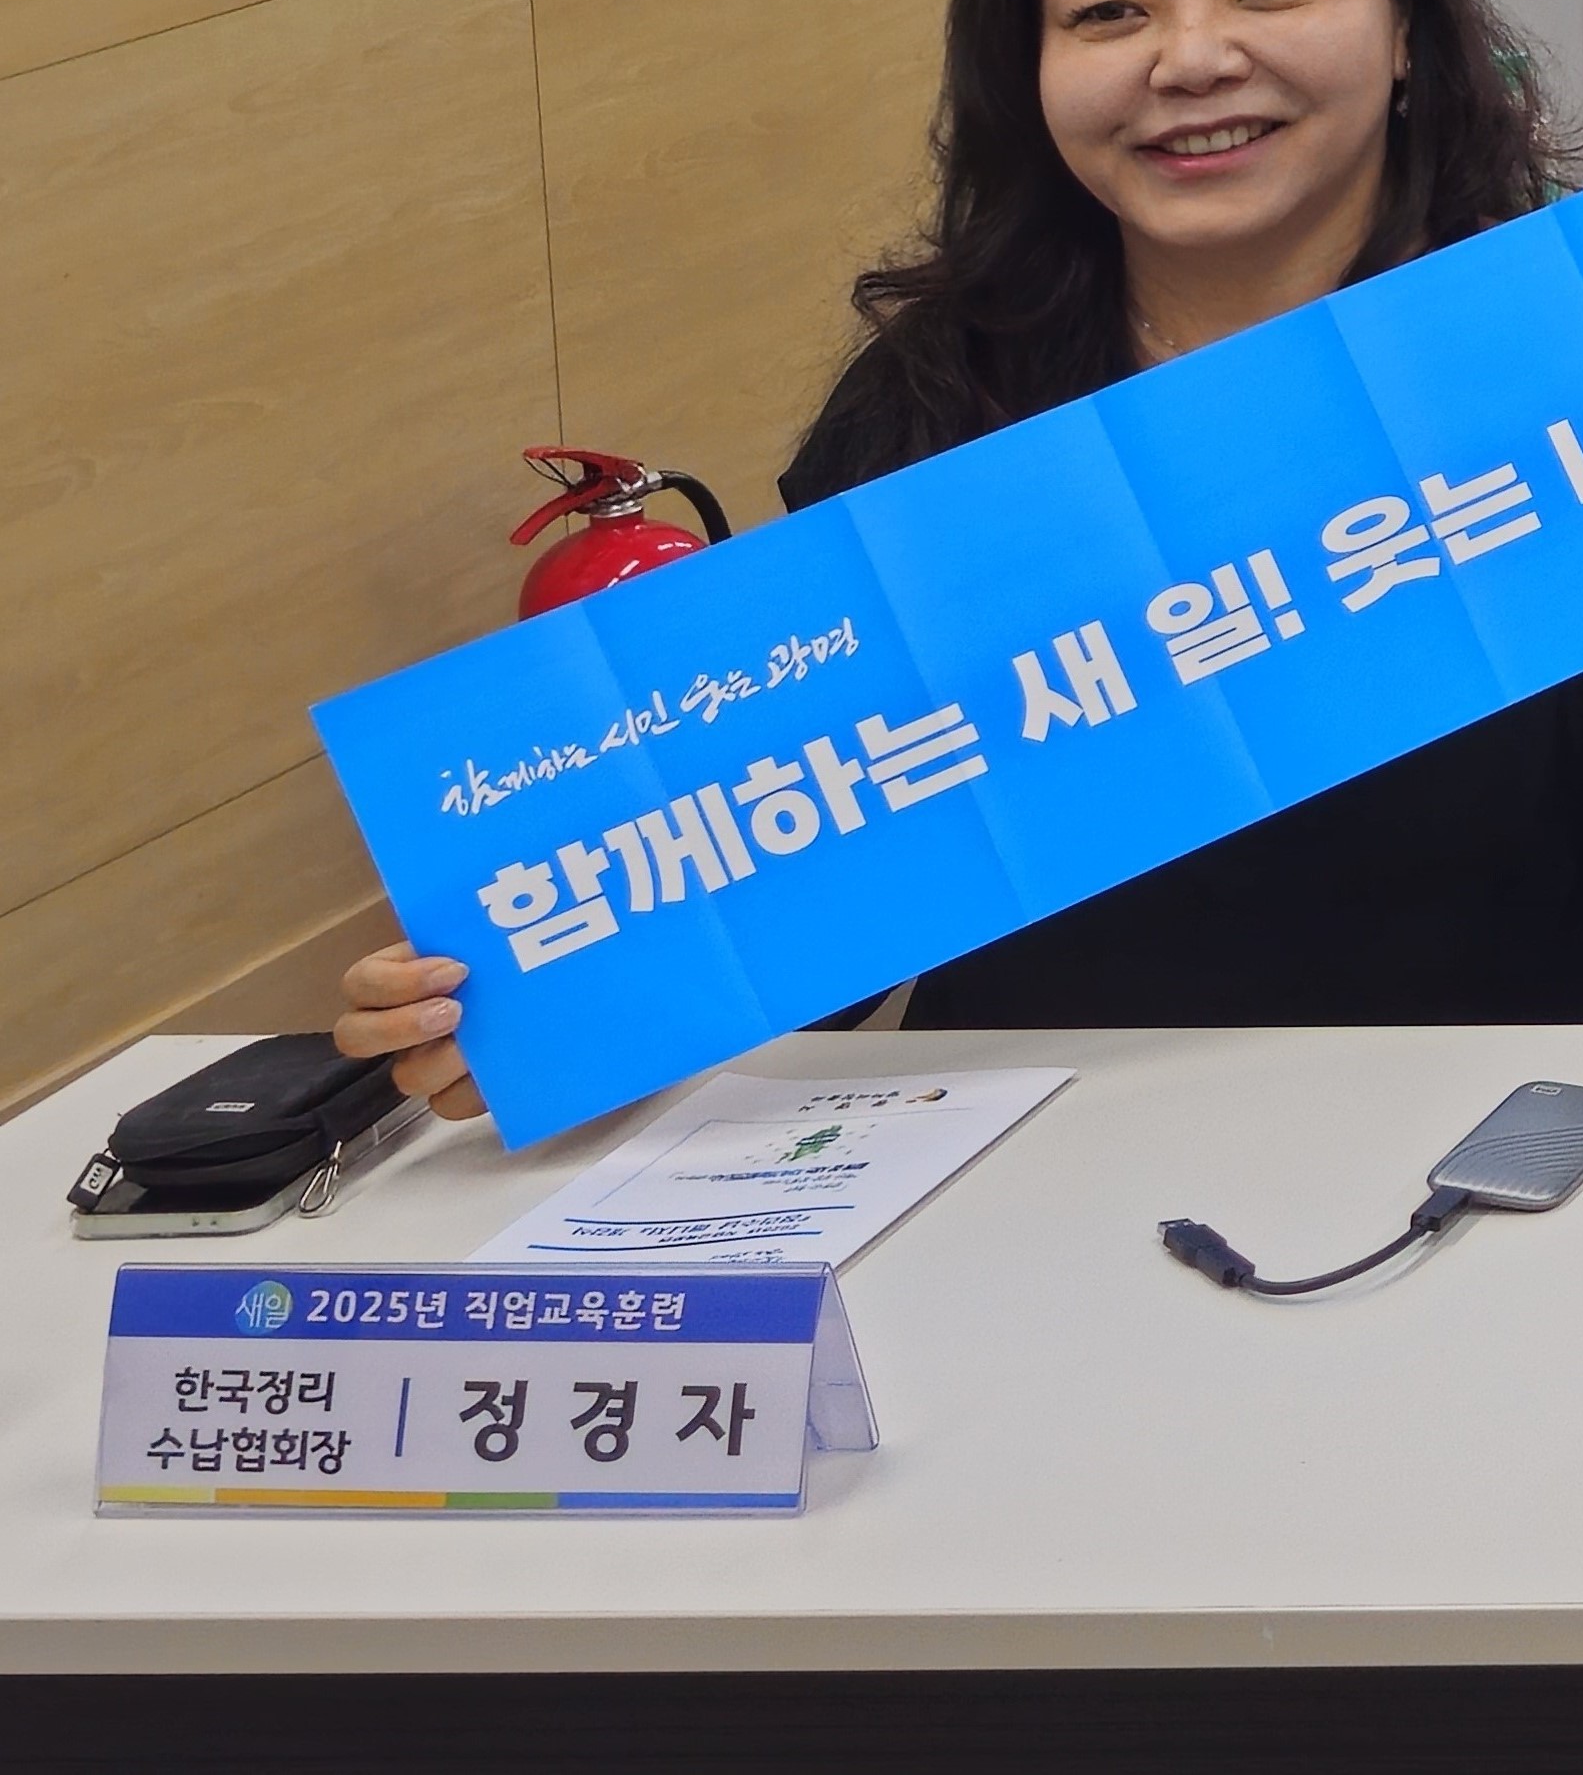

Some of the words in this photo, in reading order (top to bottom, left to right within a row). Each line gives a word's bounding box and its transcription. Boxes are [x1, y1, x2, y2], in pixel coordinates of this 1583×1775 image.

[440, 743, 597, 815] 함께하는
[599, 690, 679, 752] 시민
[679, 670, 760, 723] 웃는
[766, 617, 859, 688] 광명
[477, 702, 988, 972] 함께하는
[1012, 620, 1137, 741] 새
[1145, 548, 1304, 685] 일!
[1321, 463, 1541, 612] 웃는
[307, 1290, 447, 1328] 2025년
[466, 1291, 685, 1330] 직업교육훈련
[176, 1367, 335, 1414] 한국정리
[459, 1380, 755, 1462] 정경자
[147, 1427, 351, 1474] 수납협회장
